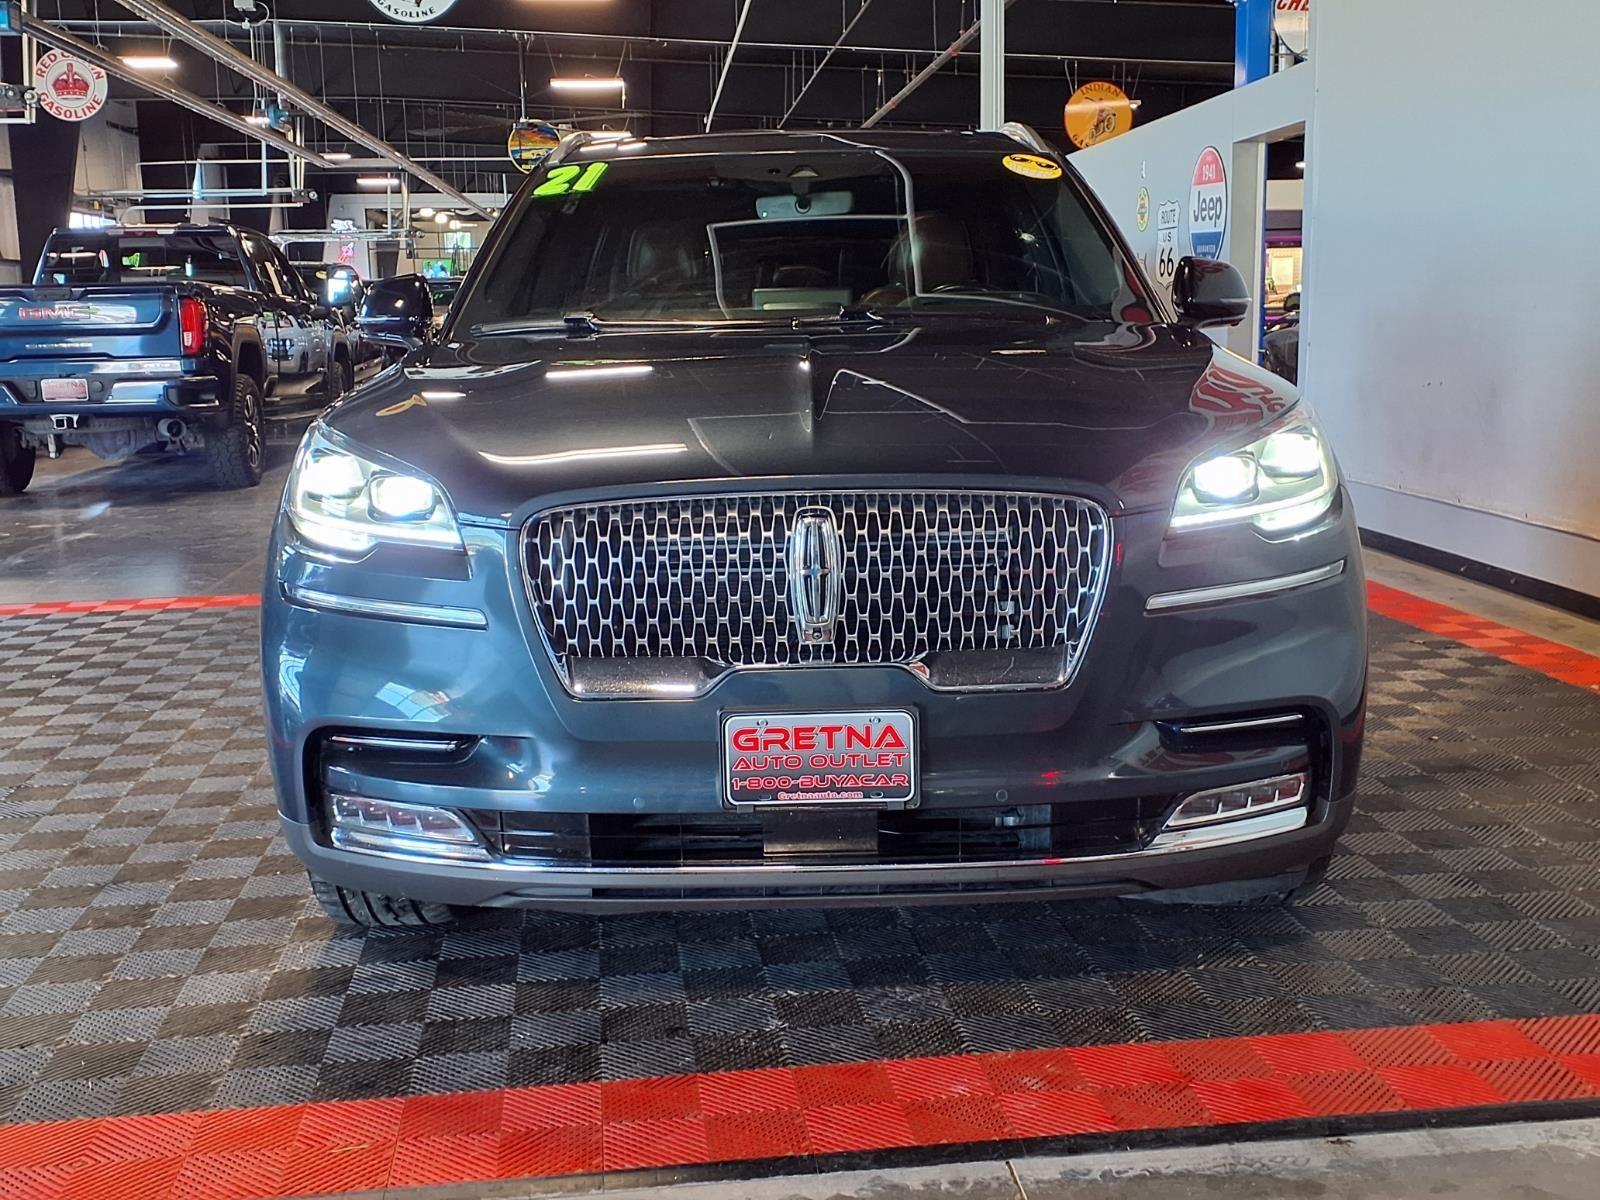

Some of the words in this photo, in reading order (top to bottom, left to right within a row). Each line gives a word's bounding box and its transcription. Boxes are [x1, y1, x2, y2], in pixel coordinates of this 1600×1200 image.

[377, 0, 436, 18] GASOLINE
[36, 53, 57, 78] RED
[1080, 83, 1120, 97] INDIAN
[40, 92, 103, 119] GASOLINE
[531, 162, 608, 198] 21
[1202, 164, 1216, 181] 1941
[1161, 209, 1176, 223] ROUTE
[1194, 190, 1222, 228] Jeep
[1159, 247, 1174, 277] 66
[19, 305, 91, 320] GMC
[732, 724, 909, 752] GRETNA
[732, 754, 803, 771] AUTO
[809, 752, 909, 769] OUTLET
[731, 774, 909, 791] 1-800-BUYACAR
[777, 790, 863, 801] Gretnaauto.com
